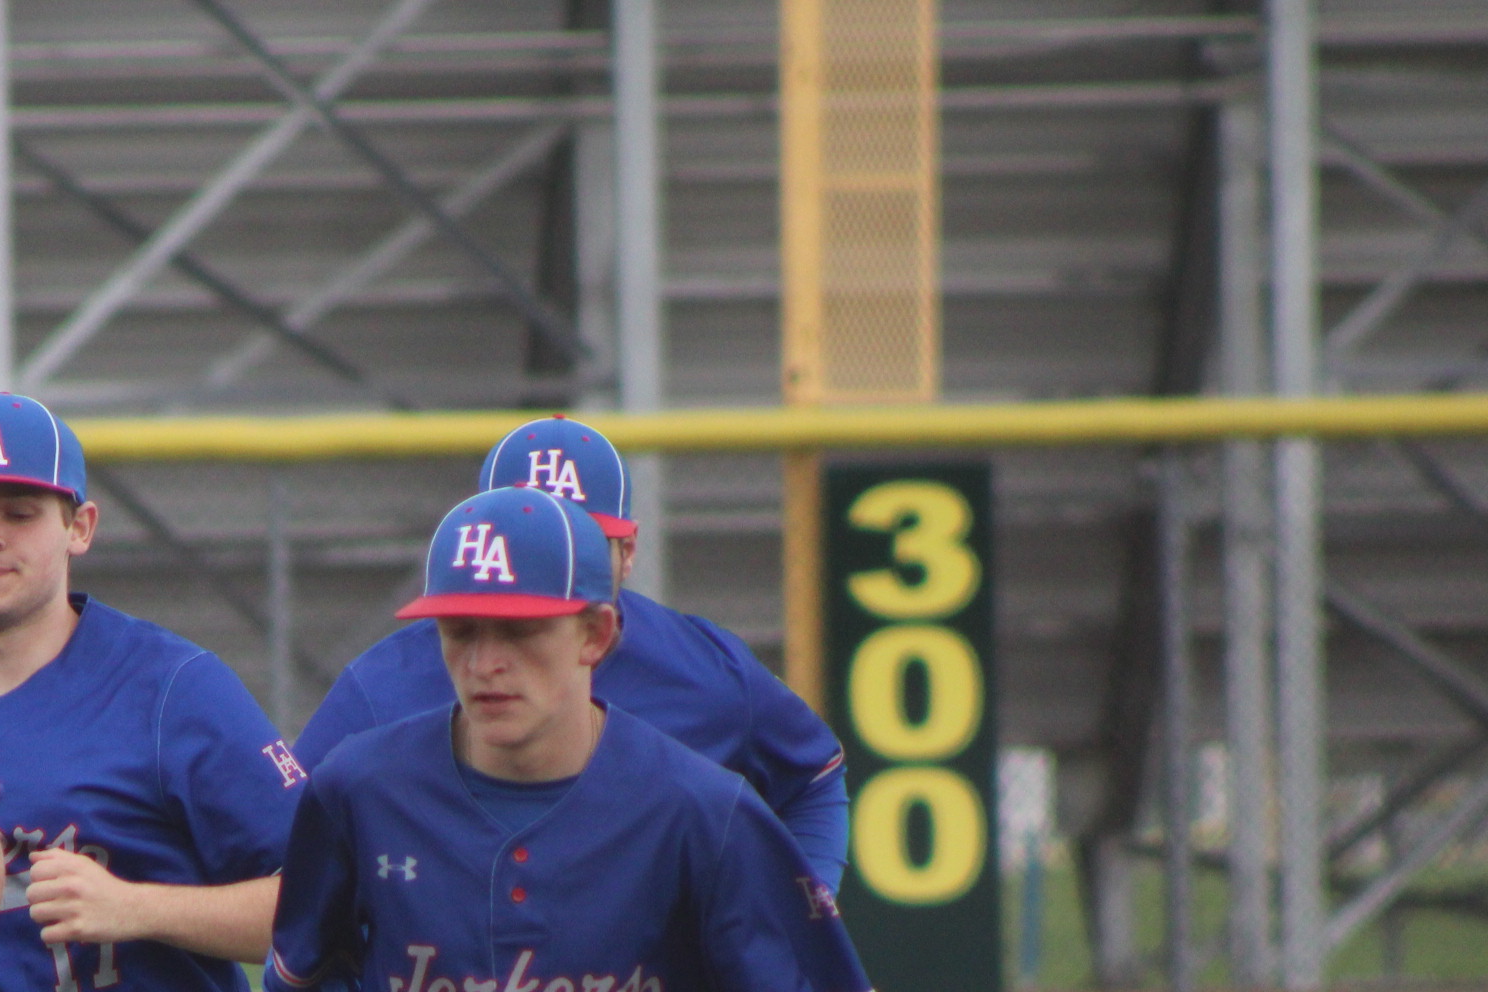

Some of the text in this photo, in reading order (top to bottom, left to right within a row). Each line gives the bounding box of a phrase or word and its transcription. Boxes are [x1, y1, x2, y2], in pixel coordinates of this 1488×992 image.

[526, 448, 586, 501] HA
[452, 523, 515, 582] HA
[848, 479, 988, 906] 300
